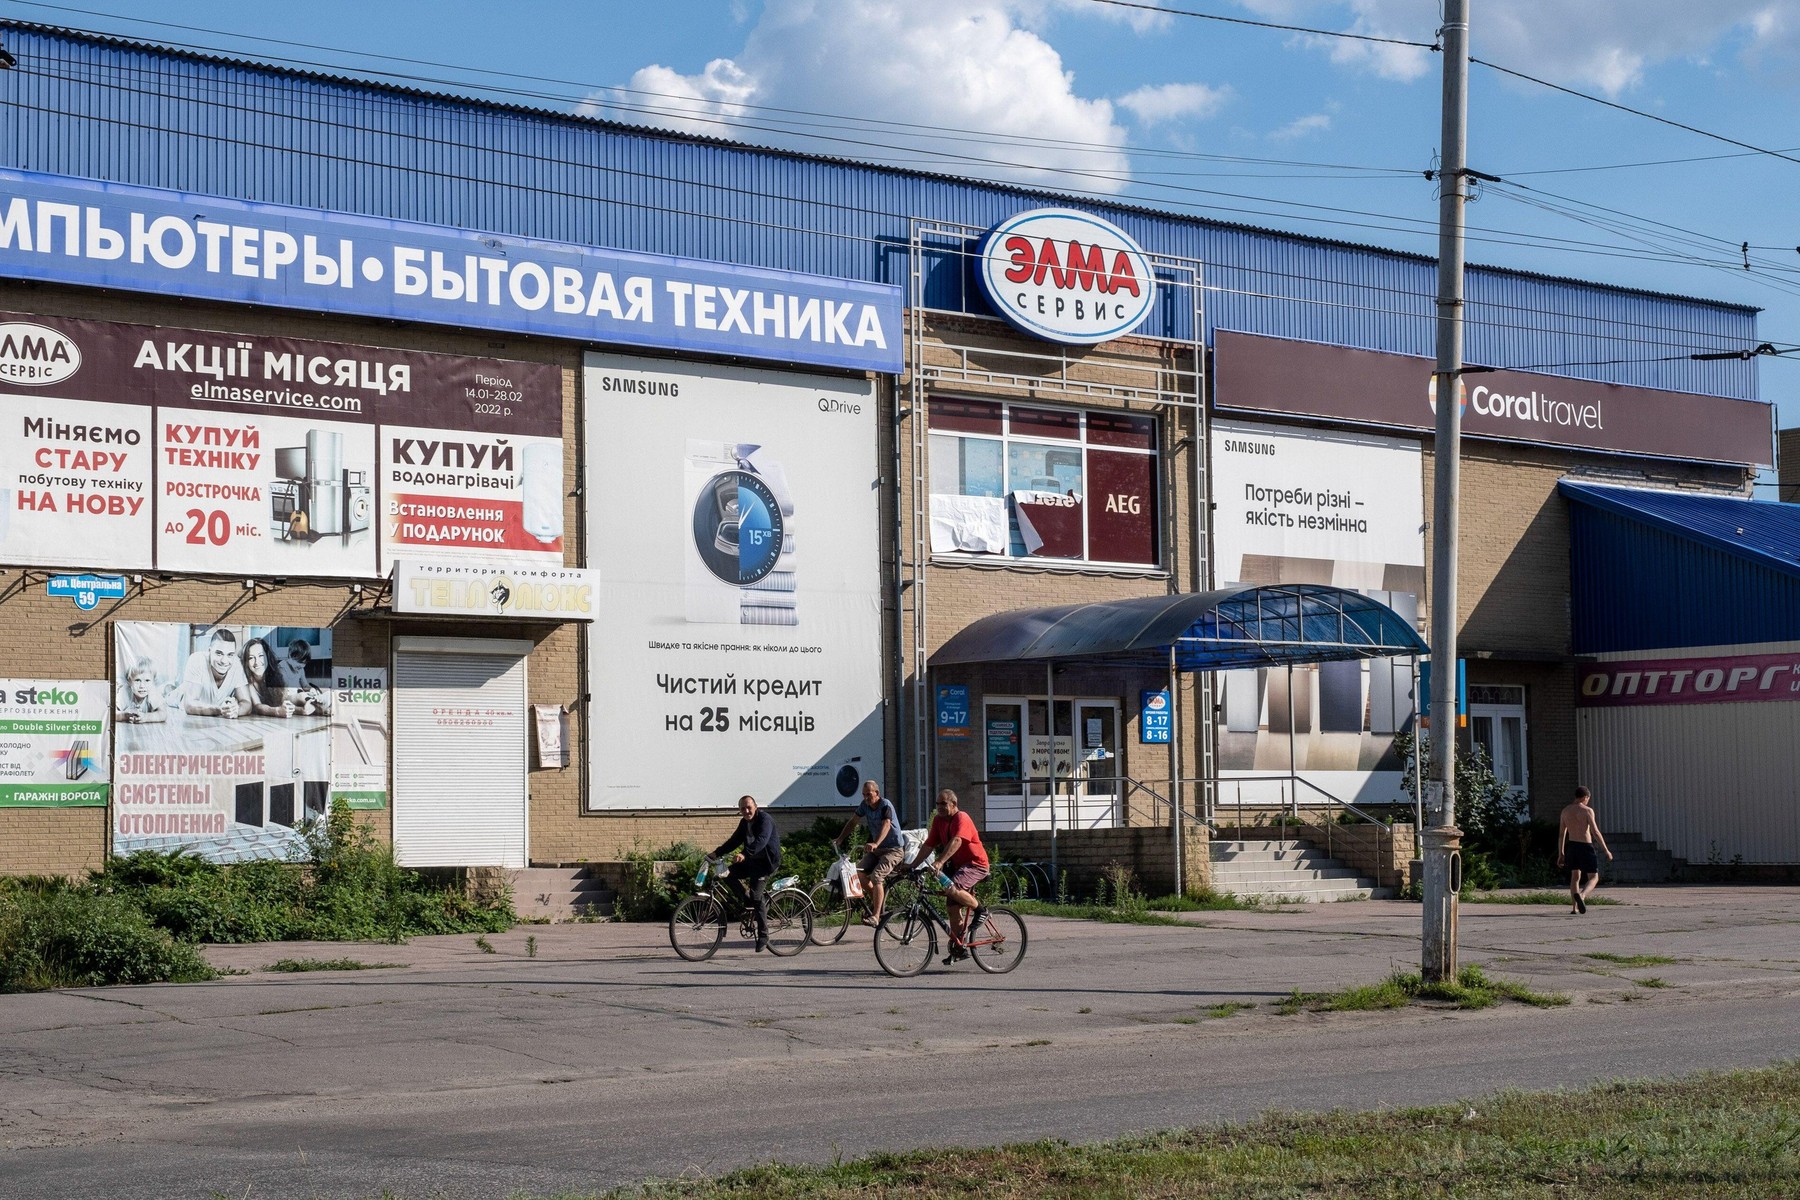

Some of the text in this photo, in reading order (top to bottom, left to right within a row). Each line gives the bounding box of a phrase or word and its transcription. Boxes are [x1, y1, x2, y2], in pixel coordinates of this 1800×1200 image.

[1005, 236, 1140, 298] ЭЛМА
[394, 246, 653, 323] БЫТОВАЯ
[667, 281, 887, 349] ТЕХНИКА
[1017, 293, 1125, 320] СЕРВИС
[0, 363, 53, 378] СЕРВІС
[133, 340, 411, 395] АКЦІЇ МІСЯЦЯ
[475, 374, 513, 388] Період
[602, 376, 679, 397] SAMSUNG
[191, 381, 361, 411] elmaservice.com
[475, 403, 513, 416] 2022 р.
[24, 416, 141, 446] Міняємо
[165, 423, 260, 449] КУПУЙ
[392, 438, 514, 472] КУПУЙ
[1224, 439, 1276, 456] SAMSUNG
[35, 448, 128, 472] СТАРУ
[165, 448, 261, 471] ТЕХНІКУ
[19, 474, 143, 492] побутову техніку
[392, 471, 514, 490] водонагрівачі
[18, 490, 144, 516] НА НОВУ
[1105, 494, 1141, 515] AEG
[1245, 483, 1312, 508] Потреби
[1317, 489, 1351, 511] різні
[389, 500, 504, 522] Встановлення
[1245, 508, 1367, 534] якість незмінна
[186, 508, 231, 546] 20
[236, 524, 262, 537] міс.
[390, 523, 505, 544] У ПОДАРУНОК
[419, 564, 582, 580] территория комфорта
[51, 578, 122, 591] вул. Центральна
[79, 591, 96, 605] 59
[648, 640, 680, 650] Швидке
[693, 642, 719, 650] якісне
[763, 644, 788, 652] ніколи
[789, 645, 799, 653] до
[800, 646, 822, 654] цього
[338, 675, 382, 689] вікна
[656, 673, 823, 701] Чистий кредит
[1581, 665, 1790, 696] ОПТТОРГ
[15, 686, 79, 705] steko
[338, 689, 381, 704] steko
[433, 708, 480, 716] ОРЕНДА
[665, 706, 815, 735] на 25 місяців
[940, 711, 967, 724] 9-17
[12, 723, 44, 731] Double
[46, 723, 70, 732] Silver
[72, 723, 97, 732] Steko
[120, 754, 266, 775] ЭЛЕКТРИЧЕСКИЕ
[13, 791, 101, 801] ГАРАЖНІ ВОРОТА
[120, 784, 211, 805] СИСТЕМЫ
[119, 813, 226, 835] ОТОПЛЕНИЯ
